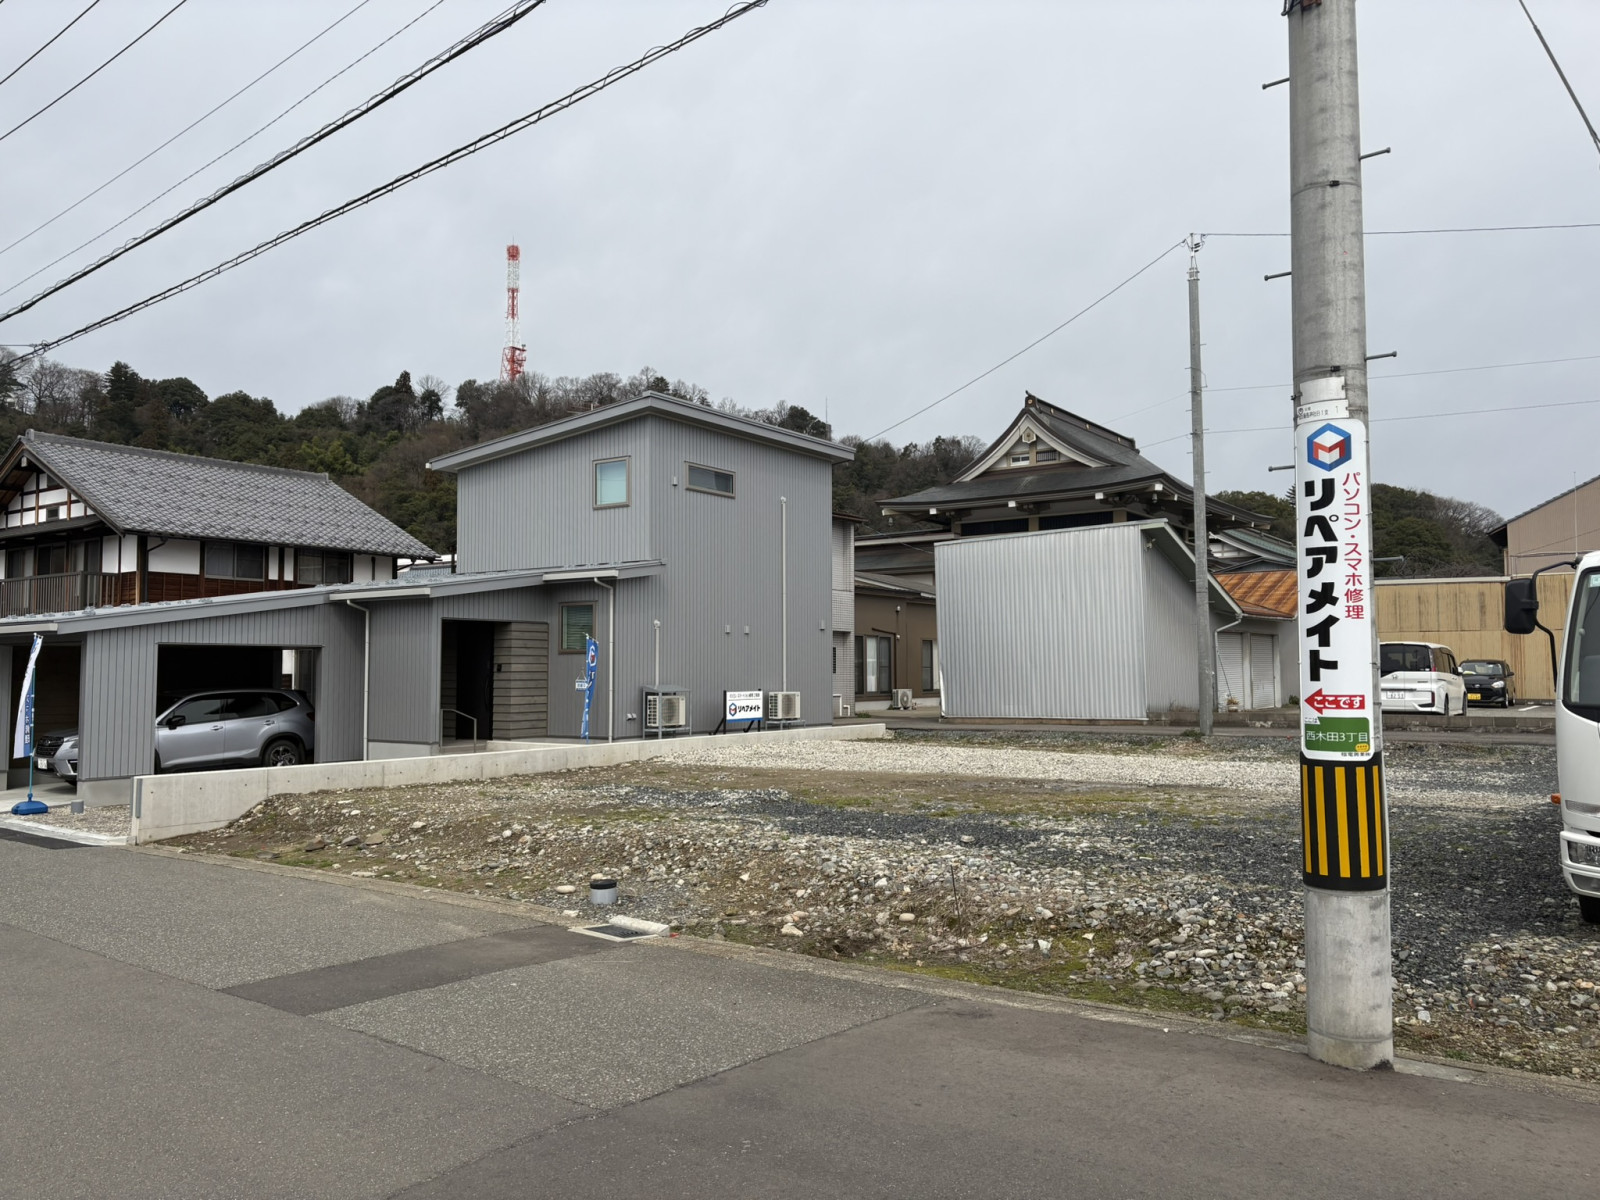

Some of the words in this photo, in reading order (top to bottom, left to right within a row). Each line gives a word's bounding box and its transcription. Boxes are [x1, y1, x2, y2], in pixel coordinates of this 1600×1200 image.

[1304, 478, 1340, 681] リペアメイト
[1342, 472, 1365, 619] パソコン・スマホ修理
[1306, 731, 1368, 742] 西木田3丁目
[1313, 696, 1362, 709] ここです
